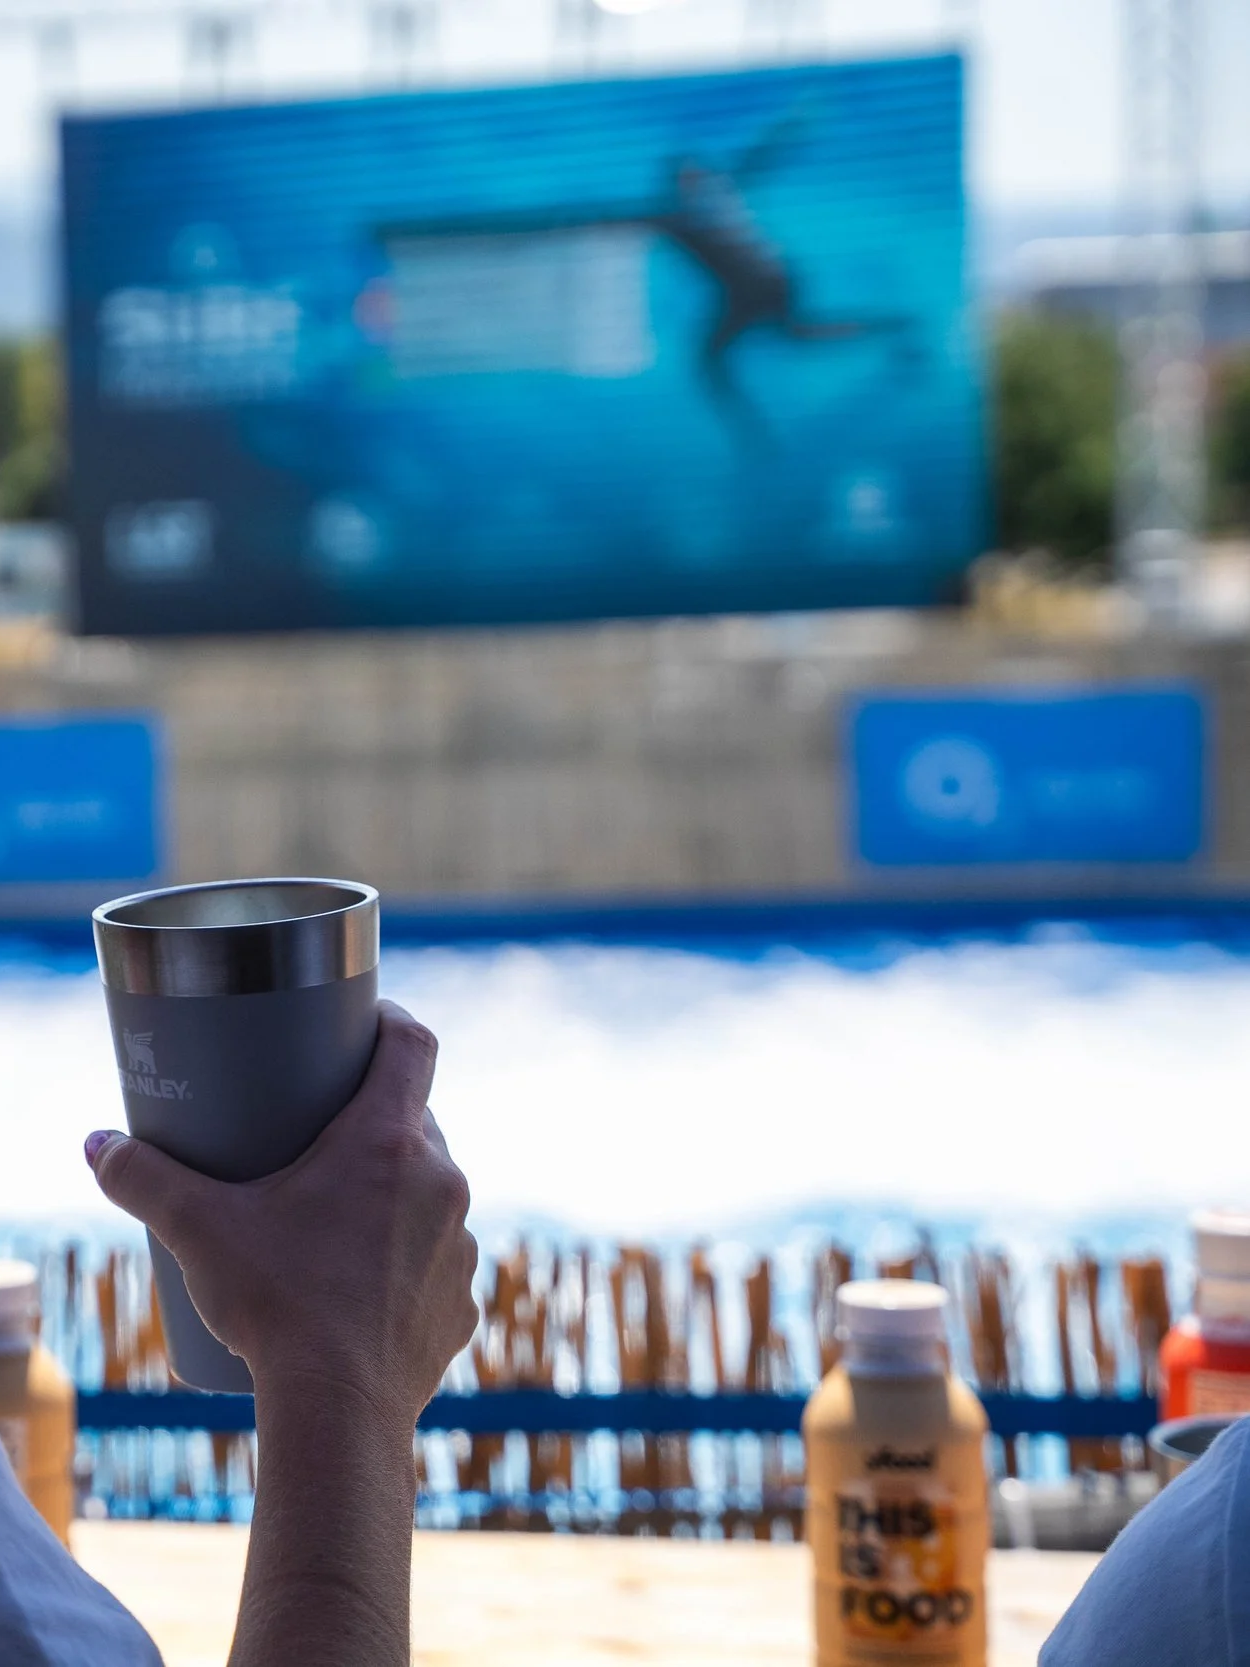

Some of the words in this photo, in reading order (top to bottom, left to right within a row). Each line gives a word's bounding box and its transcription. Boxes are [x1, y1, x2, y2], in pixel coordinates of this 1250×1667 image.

[119, 1069, 189, 1100] ANLEY
[836, 1494, 937, 1538] THIS
[840, 1586, 973, 1628] FOOD
